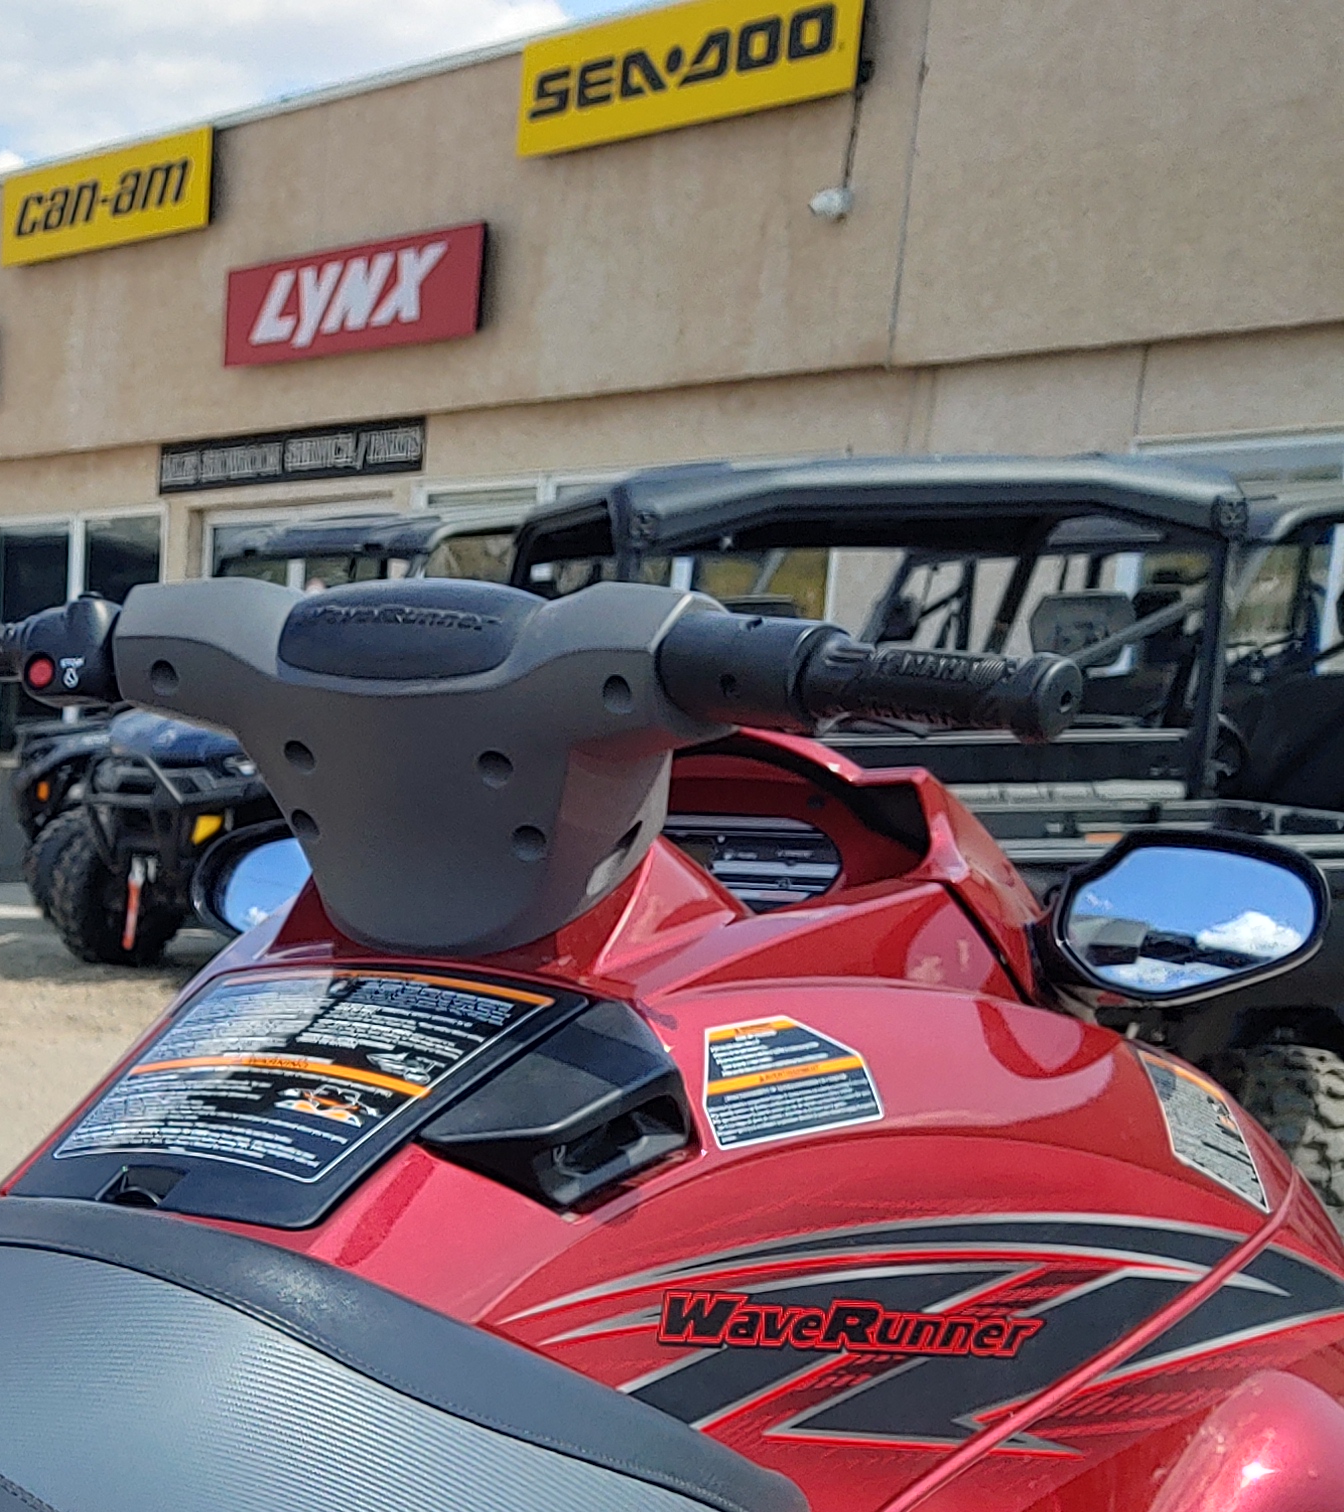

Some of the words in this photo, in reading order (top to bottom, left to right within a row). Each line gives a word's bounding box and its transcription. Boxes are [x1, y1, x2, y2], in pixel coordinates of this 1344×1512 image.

[14, 158, 190, 239] can-am
[248, 241, 449, 349] LYNX
[657, 1290, 1046, 1358] WaveRunner
